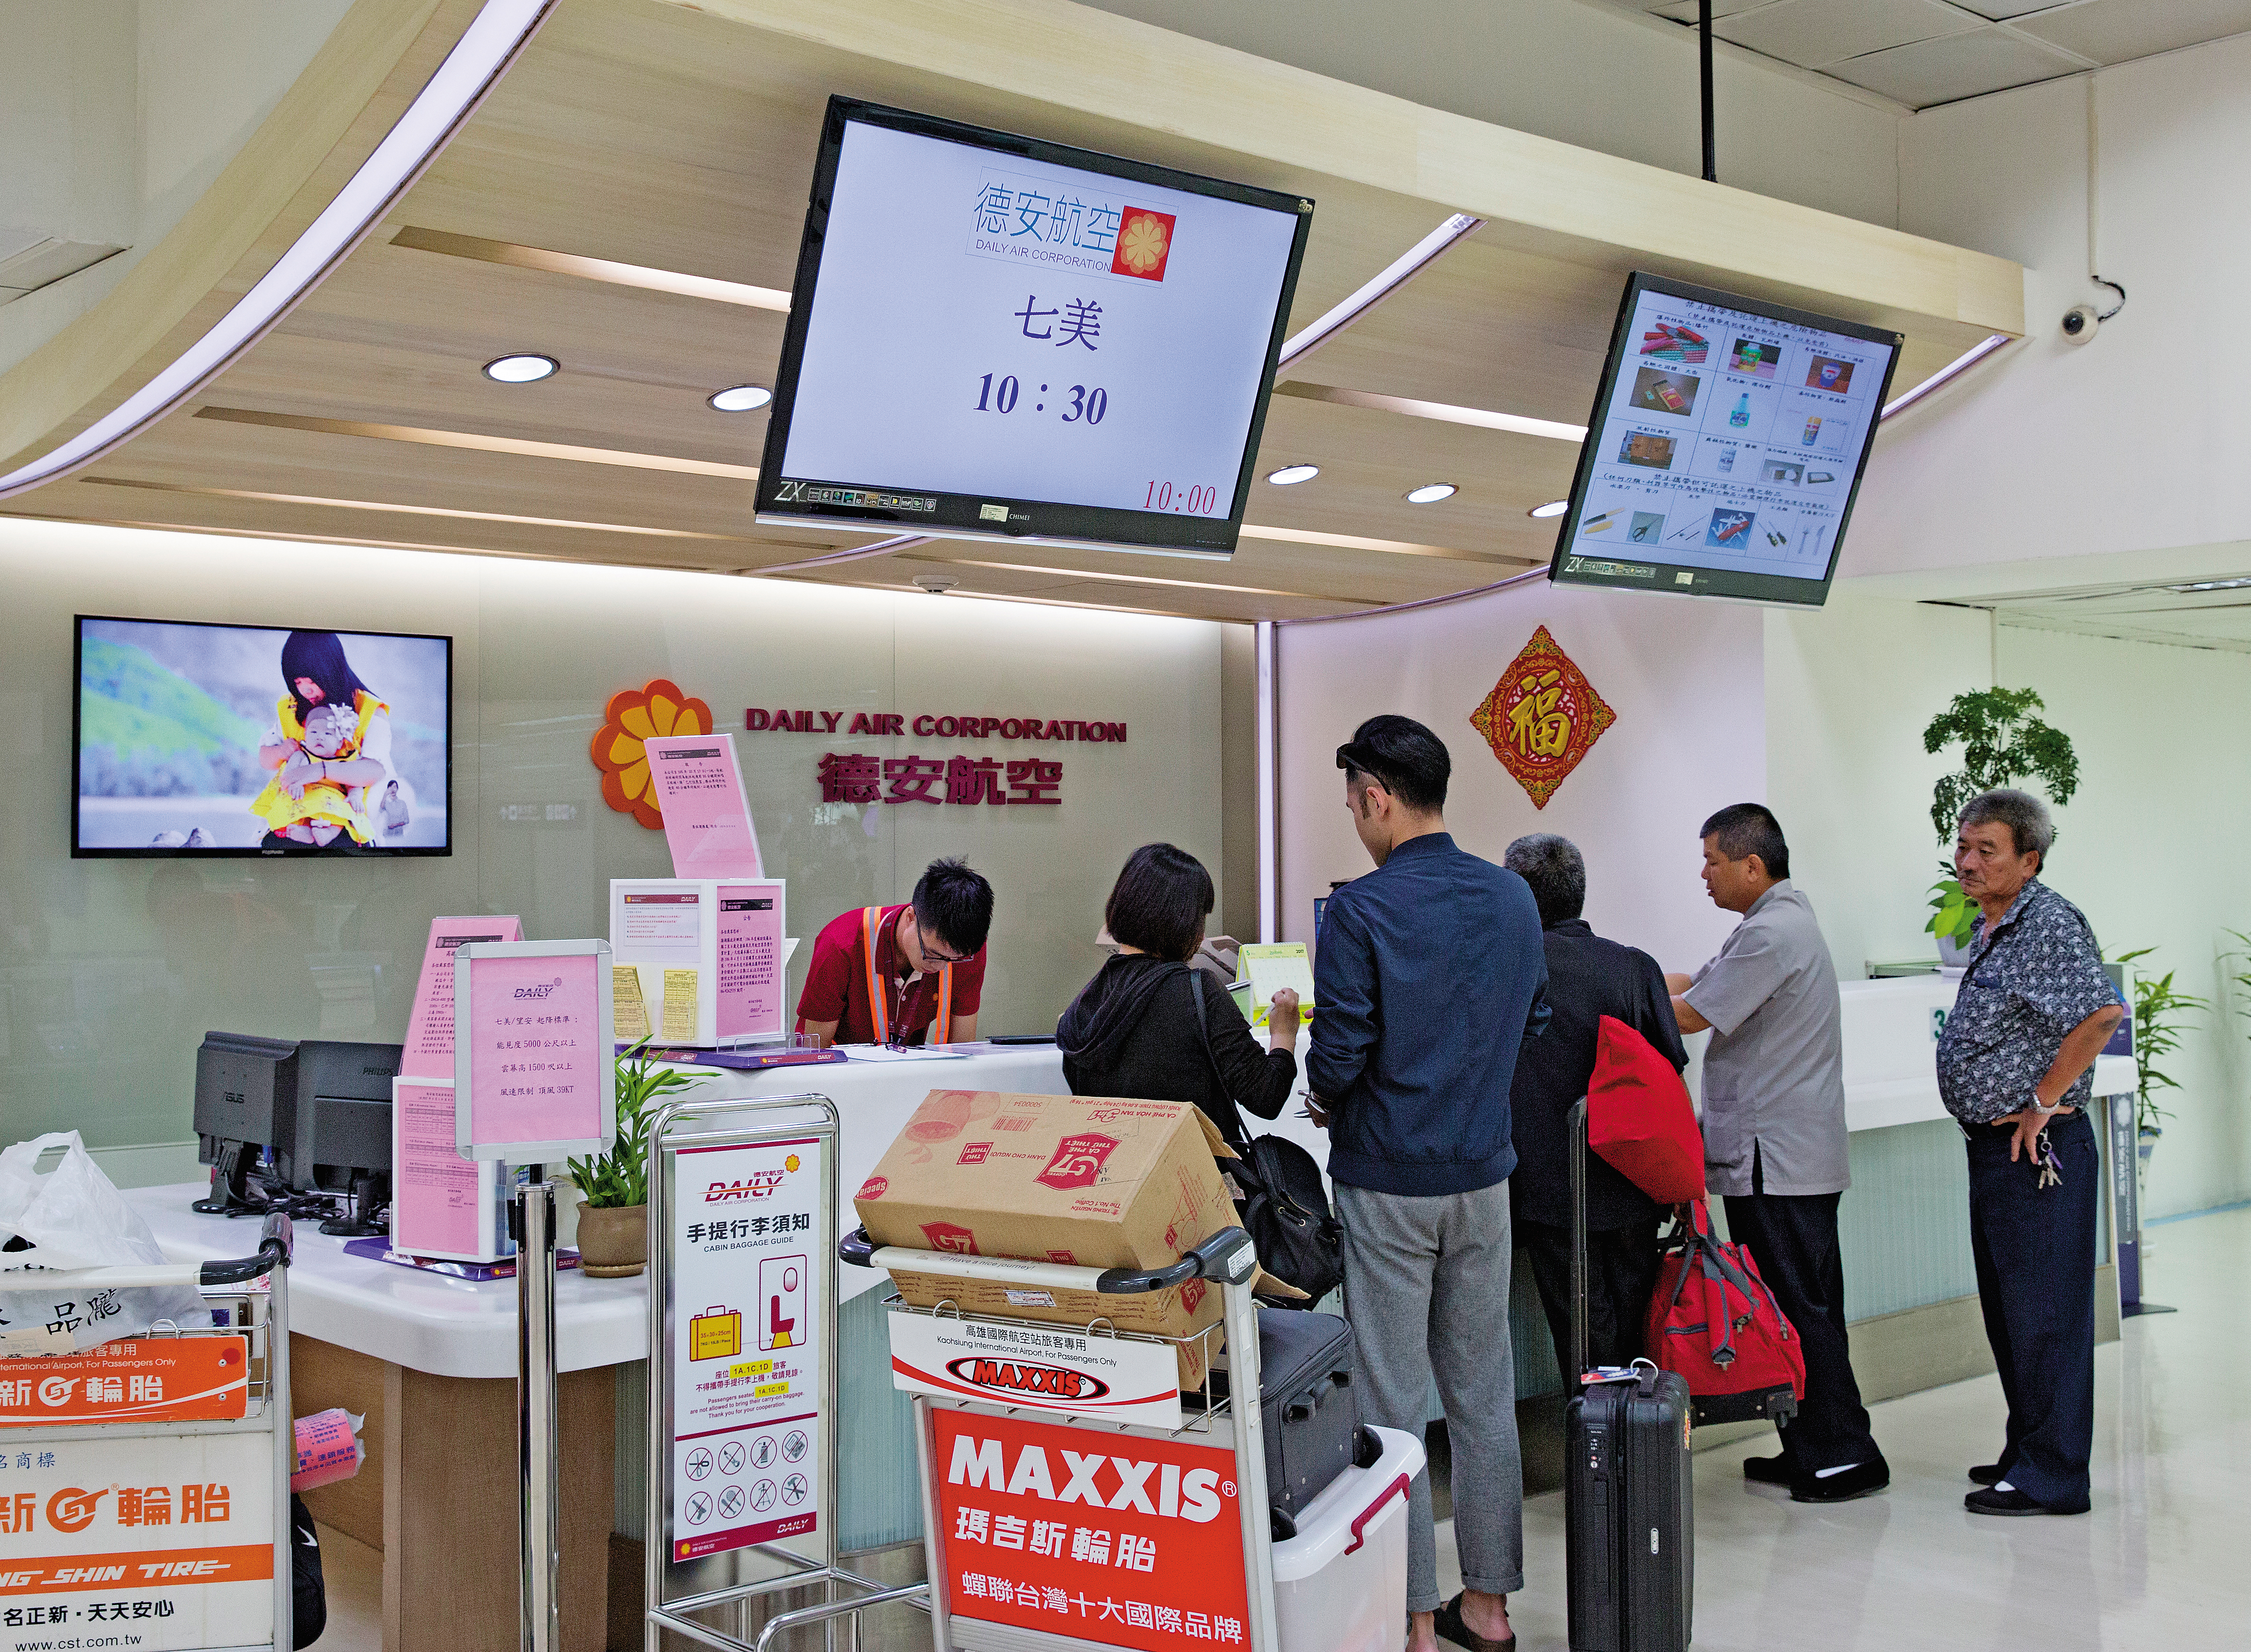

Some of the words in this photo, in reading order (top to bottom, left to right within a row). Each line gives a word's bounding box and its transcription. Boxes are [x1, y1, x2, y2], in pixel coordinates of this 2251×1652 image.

[974, 181, 1121, 253] 德安航空
[976, 239, 1008, 253] DAILY
[1010, 246, 1029, 257] AIR
[1032, 250, 1111, 272] CORPORATION
[1014, 295, 1104, 351] 七美
[774, 481, 806, 502] ZX
[1143, 480, 1216, 515] 10:00
[1009, 513, 1030, 521] CHIMEI
[1565, 557, 1585, 572] ZX
[1509, 669, 1571, 757] 福
[746, 708, 844, 735] DAILY
[848, 713, 905, 736] AIR
[912, 715, 1127, 743] CORPORATION
[818, 752, 1063, 806] 德安航空
[514, 988, 553, 998] DAILY
[495, 1017, 532, 1026] 七美/望安
[497, 1040, 521, 1049] 能見度
[524, 1040, 541, 1048] 5000
[544, 1039, 577, 1048] 公尺以上
[362, 1067, 393, 1076] PHILIPS
[529, 1063, 545, 1071] 1500
[557, 1086, 574, 1094] 39KT
[753, 1169, 785, 1178] 德安航空
[705, 1176, 784, 1202] DAILY
[734, 1197, 769, 1205] CORPORATION
[687, 1213, 810, 1243] 手提行李須知
[704, 1244, 728, 1252] CABIN
[730, 1239, 769, 1250] BAGGAGE
[771, 1236, 794, 1245] GUIDE
[998, 1263, 1036, 1271] journey!
[965, 1325, 1087, 1352] 高雄國際航空站旅客專用
[937, 1336, 974, 1350] Kaohsiung
[974, 1341, 1018, 1353] International
[1019, 1346, 1044, 1358] Airport,
[1045, 1350, 1056, 1358] For
[1058, 1351, 1099, 1365] Passengers
[1100, 1357, 1117, 1368] Only
[86, 1360, 98, 1369] For
[102, 1358, 153, 1369] Passengers
[155, 1358, 177, 1368] Only
[715, 1369, 729, 1379] 座位
[734, 1363, 769, 1375] 1A.1C.1D
[773, 1361, 786, 1370] 旅客
[972, 1359, 1082, 1397] MAXXIS
[86, 1375, 163, 1403] 輪胎
[708, 1395, 737, 1404] Passengers
[738, 1391, 754, 1399] seated
[758, 1385, 785, 1395] 1A.1C.1D
[749, 1397, 760, 1405] their
[761, 1394, 782, 1404] carry-on
[783, 1390, 805, 1400] baggage.
[743, 1407, 755, 1415] your
[756, 1401, 786, 1412] cooperation.
[948, 1434, 1221, 1523] MAXXIS
[118, 1483, 230, 1527] 輪胎
[776, 1519, 809, 1534] DAILY
[955, 1506, 1157, 1573] 瑪吉斯輪胎
[40, 1566, 127, 1586] SHIN
[138, 1559, 232, 1579] TIRE
[961, 1570, 1243, 1644] 蟬聯台灣十大國際品牌
[15, 1634, 142, 1652] www.cst.com.tw
